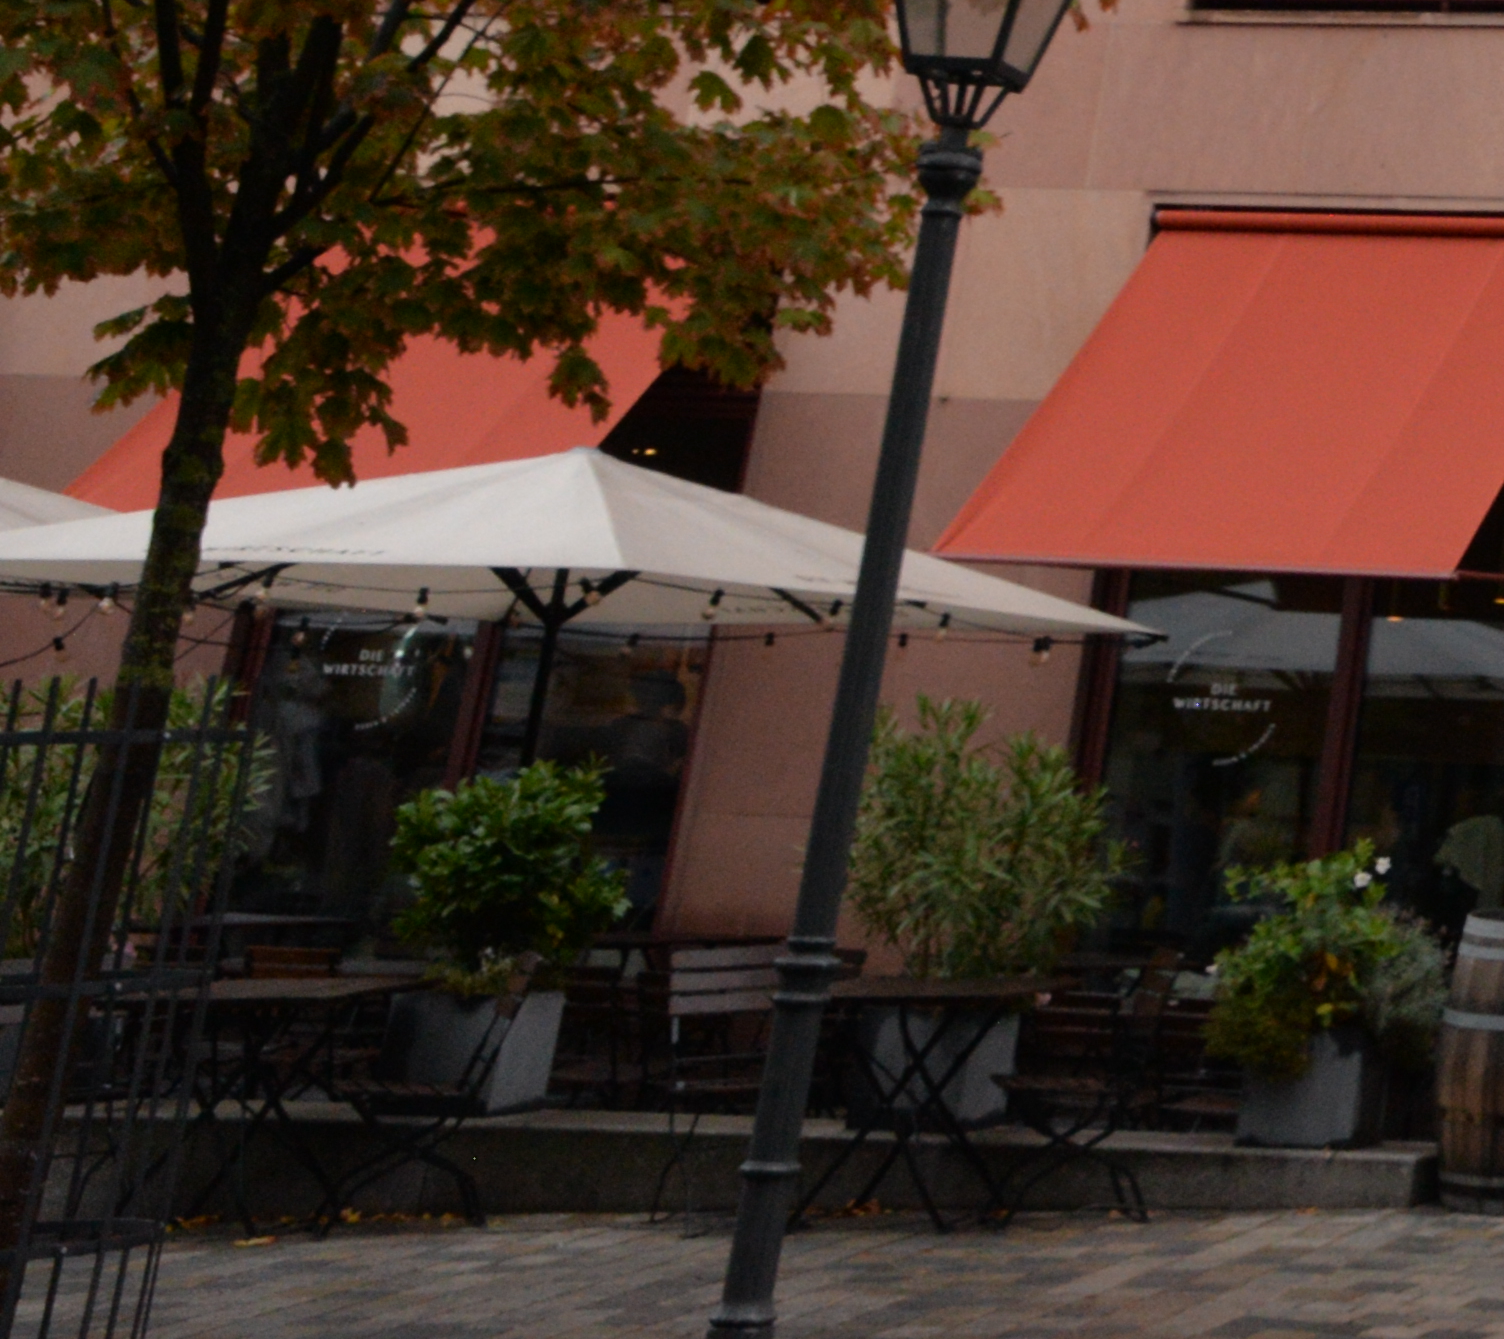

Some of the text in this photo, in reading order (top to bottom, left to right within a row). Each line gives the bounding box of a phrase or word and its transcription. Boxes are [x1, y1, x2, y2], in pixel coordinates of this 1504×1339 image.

[358, 648, 384, 663] DIE
[1210, 682, 1238, 696] DIE
[1172, 696, 1272, 713] WIRTSCHAFT
